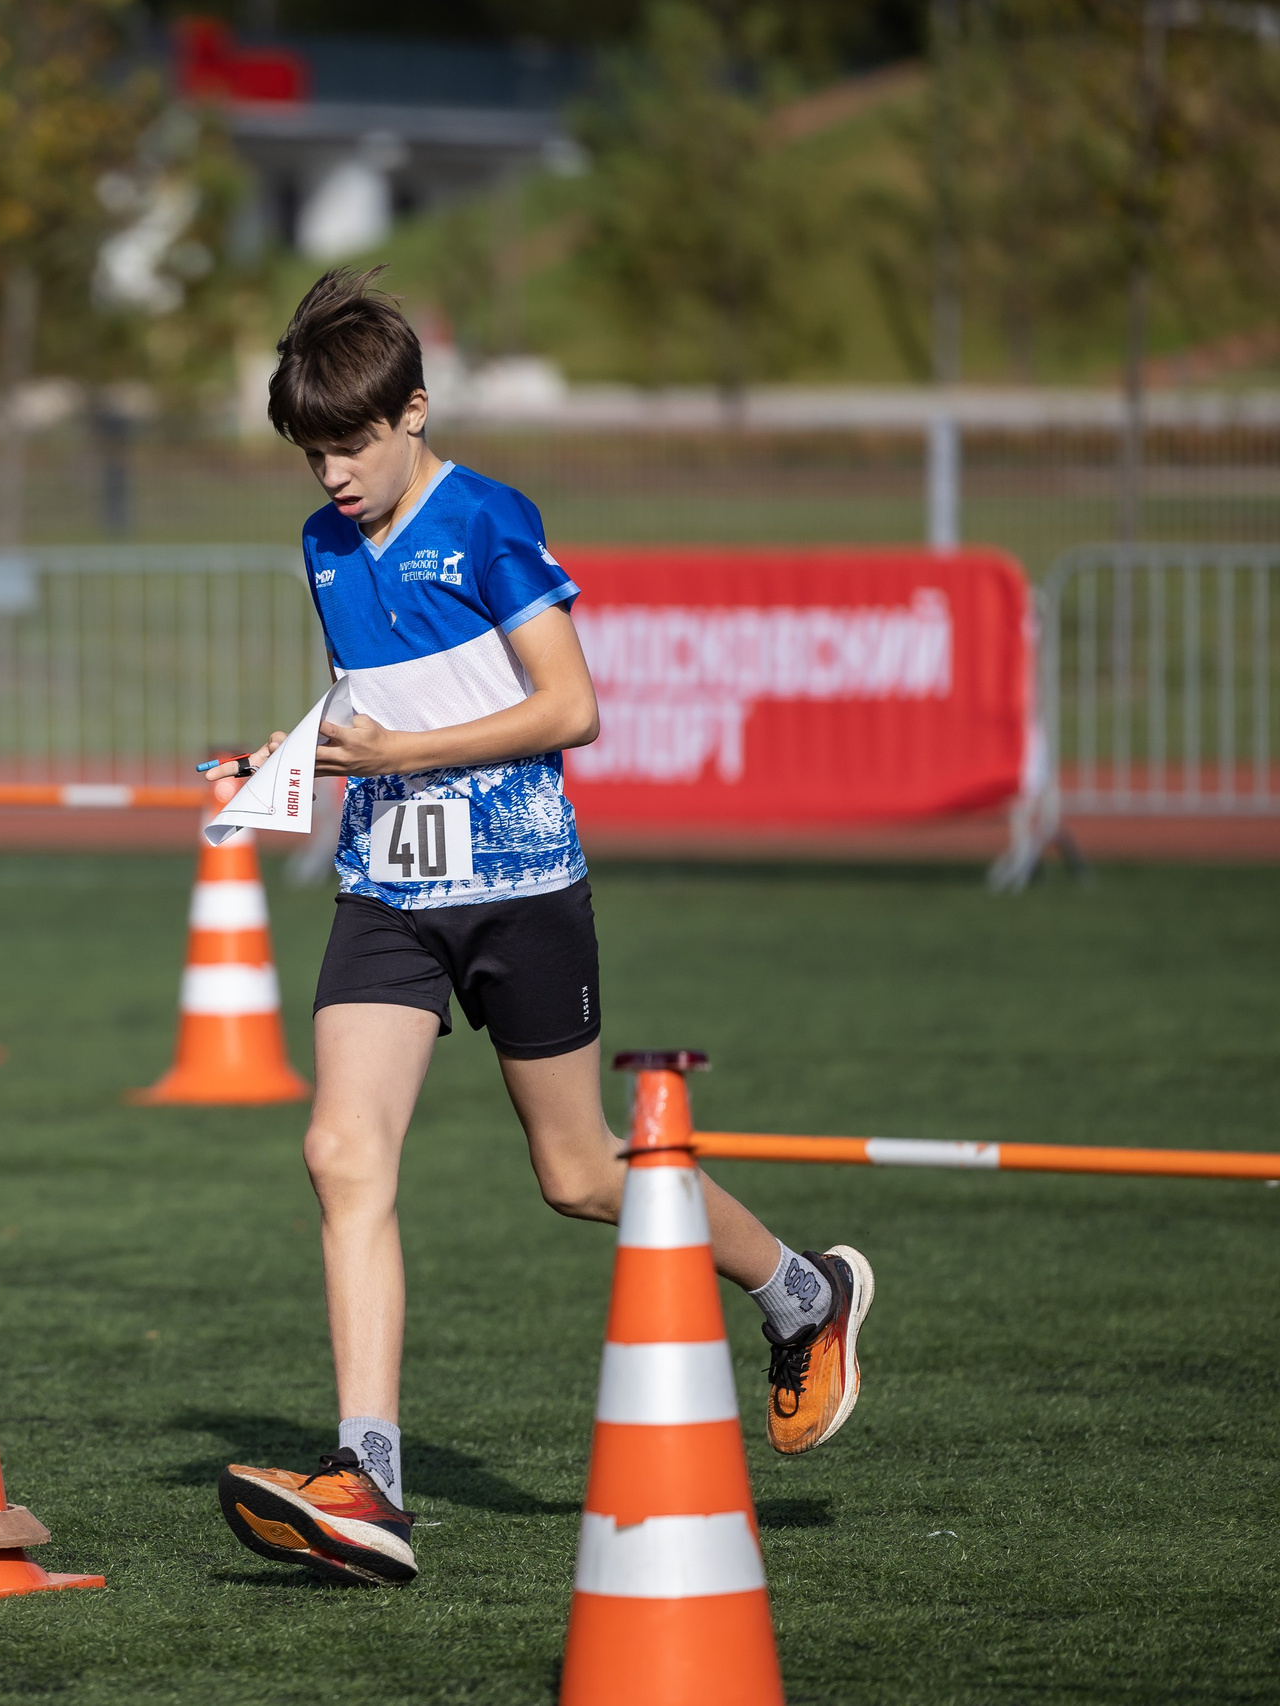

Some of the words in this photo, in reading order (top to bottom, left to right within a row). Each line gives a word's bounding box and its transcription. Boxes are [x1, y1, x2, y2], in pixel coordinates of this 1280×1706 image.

[288, 778, 301, 788] Ж
[290, 768, 302, 776] А
[286, 790, 300, 818] КВАЛ
[388, 804, 447, 878] 40
[581, 985, 590, 1023] KIPSTA
